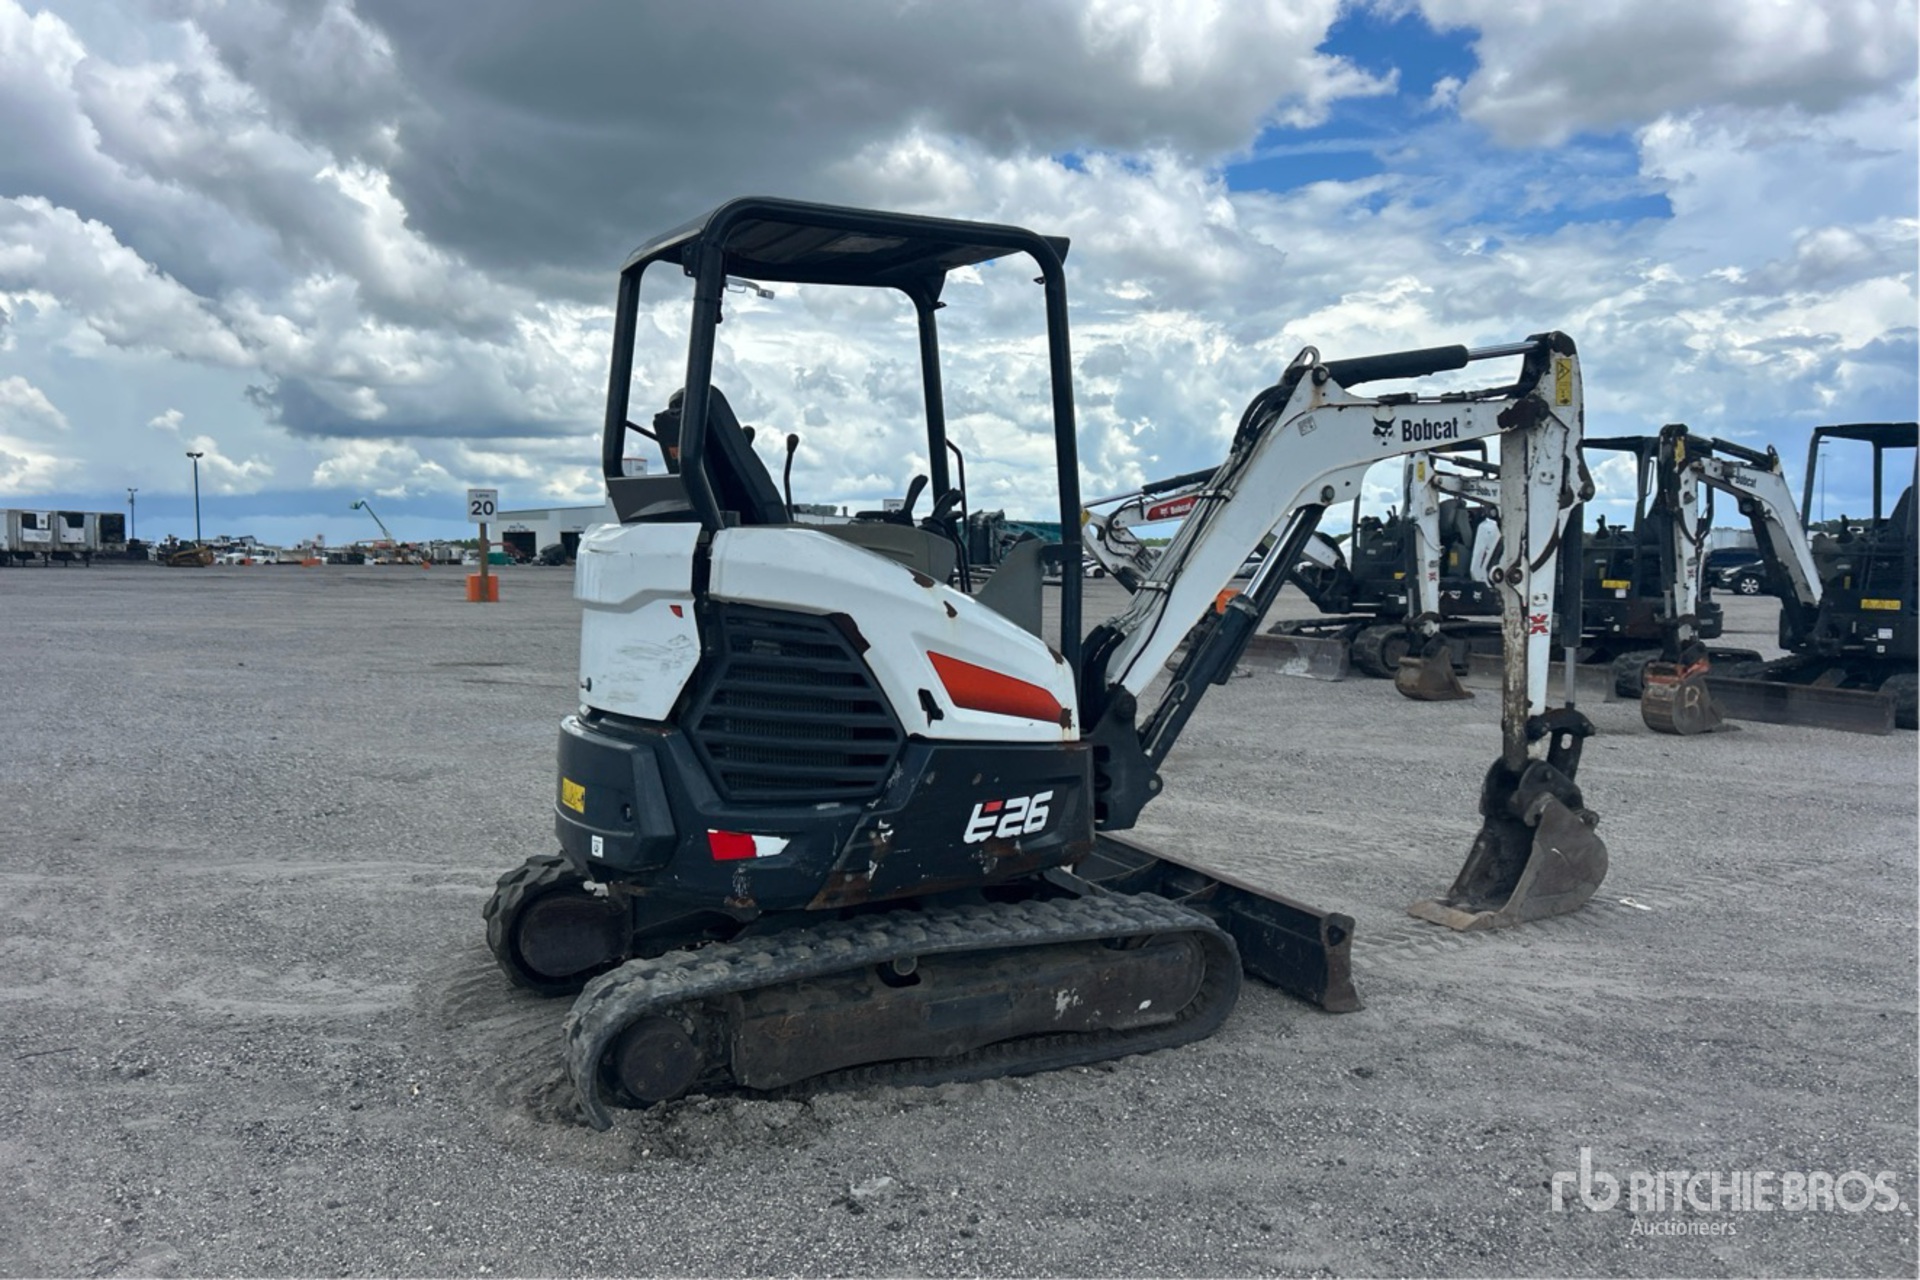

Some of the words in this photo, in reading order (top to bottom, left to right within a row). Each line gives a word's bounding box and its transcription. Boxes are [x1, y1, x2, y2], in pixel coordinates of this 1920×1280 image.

[1402, 417, 1459, 442] Bobcat
[471, 500, 495, 516] 20
[963, 790, 1054, 844] E26
